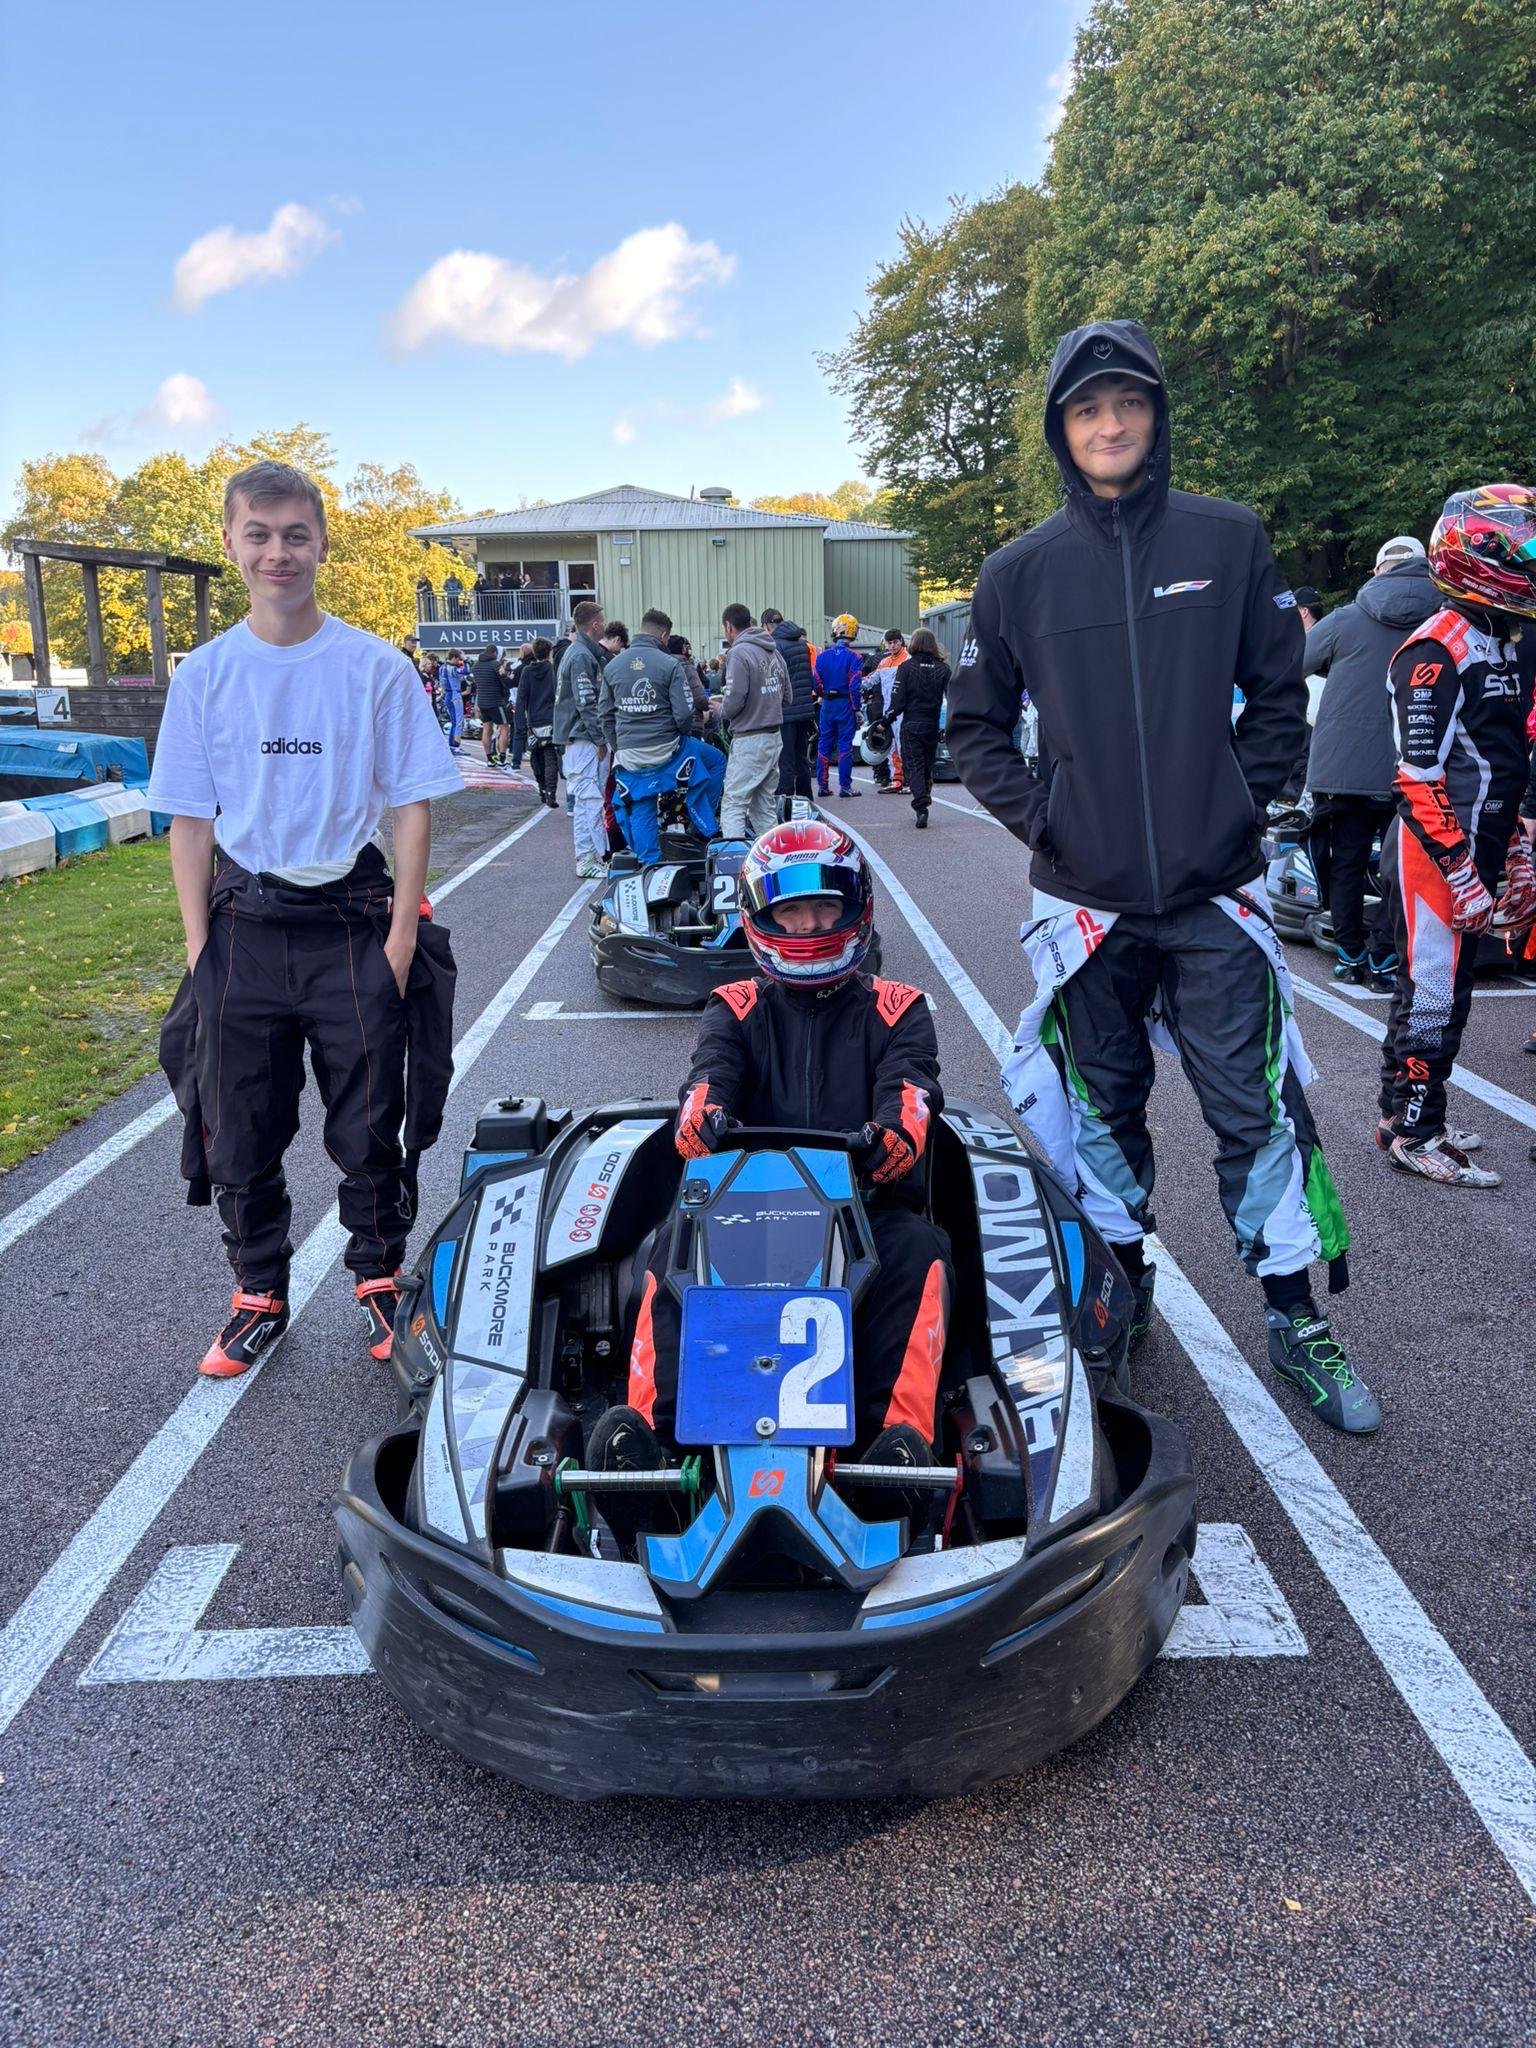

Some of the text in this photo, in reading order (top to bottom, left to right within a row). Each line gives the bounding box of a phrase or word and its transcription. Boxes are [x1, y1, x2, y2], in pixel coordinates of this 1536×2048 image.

[439, 629, 538, 643] ANDERSEN
[53, 696, 70, 720] 4
[1413, 690, 1432, 699] OMP
[260, 737, 323, 754] adidas
[1484, 801, 1503, 811] OMP
[598, 1151, 623, 1183] SODI
[479, 1242, 498, 1291] PARK
[487, 1242, 517, 1347] BUCKMORE
[419, 1330, 442, 1370] SODI
[778, 1296, 848, 1429] 2
